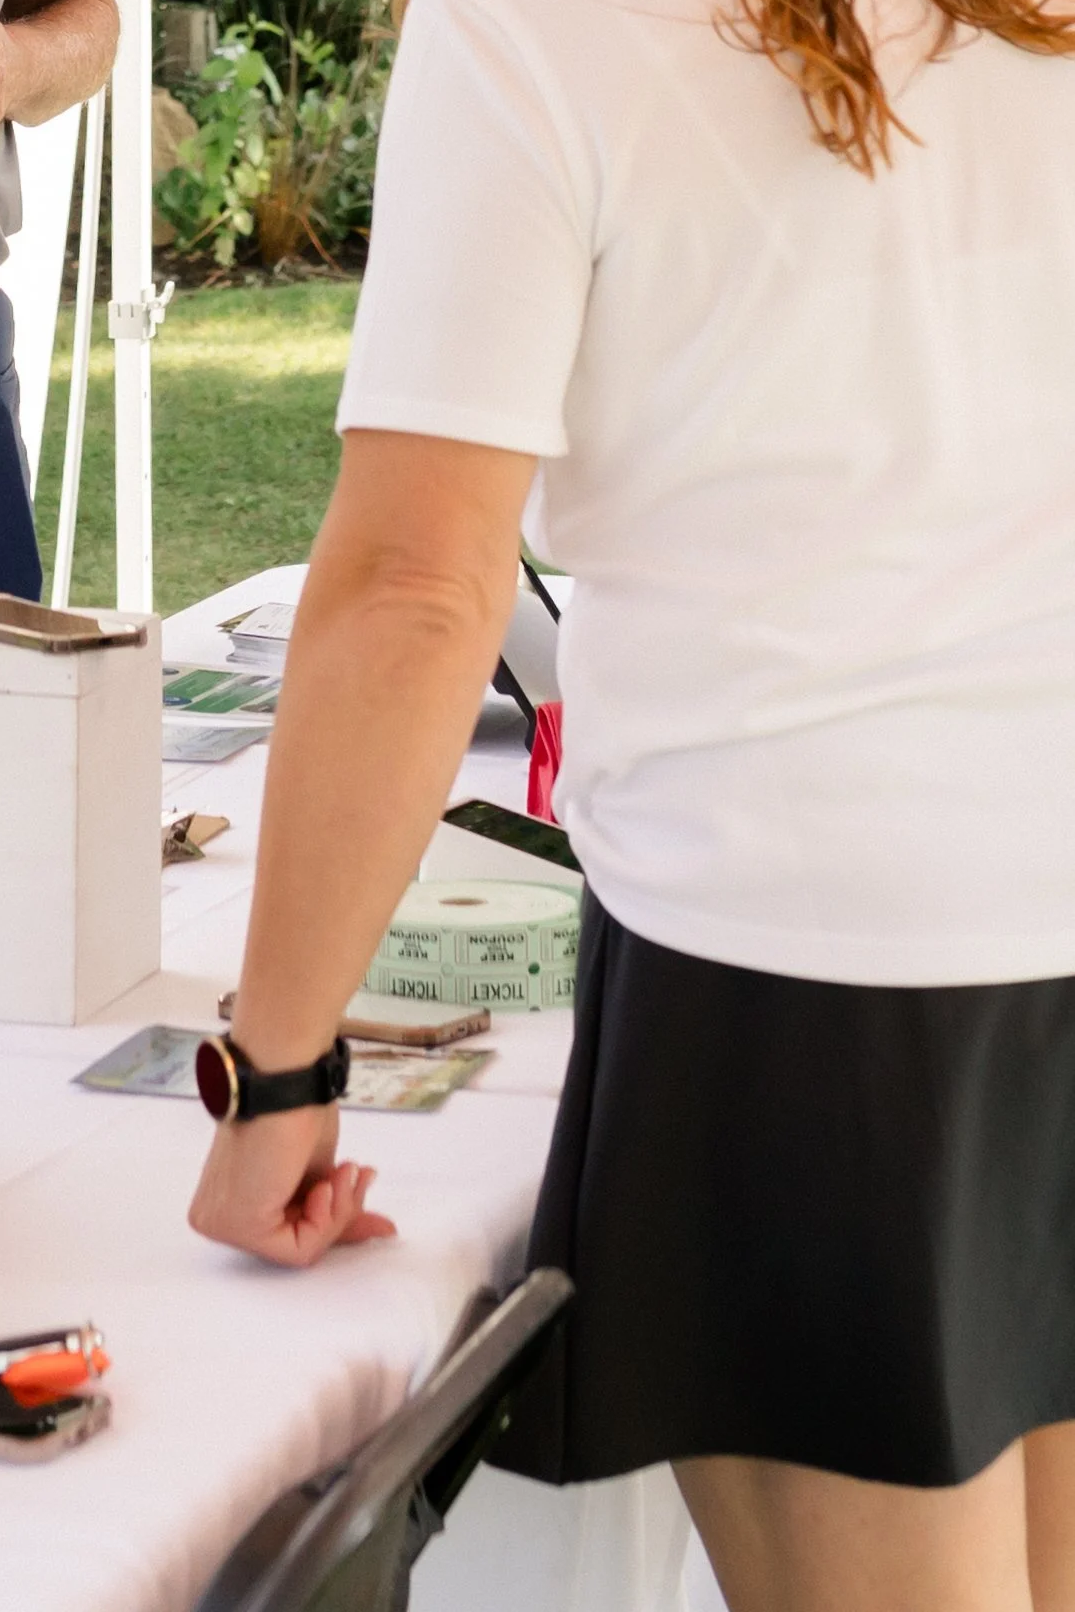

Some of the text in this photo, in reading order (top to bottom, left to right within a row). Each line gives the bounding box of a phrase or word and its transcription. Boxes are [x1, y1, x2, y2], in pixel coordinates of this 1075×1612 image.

[389, 929, 437, 942] COUPON
[470, 933, 524, 944] COUPON
[398, 949, 428, 959] KEEP
[481, 951, 514, 962] KEEP
[391, 978, 438, 1001] TICKET
[471, 982, 524, 1001] TICKET
